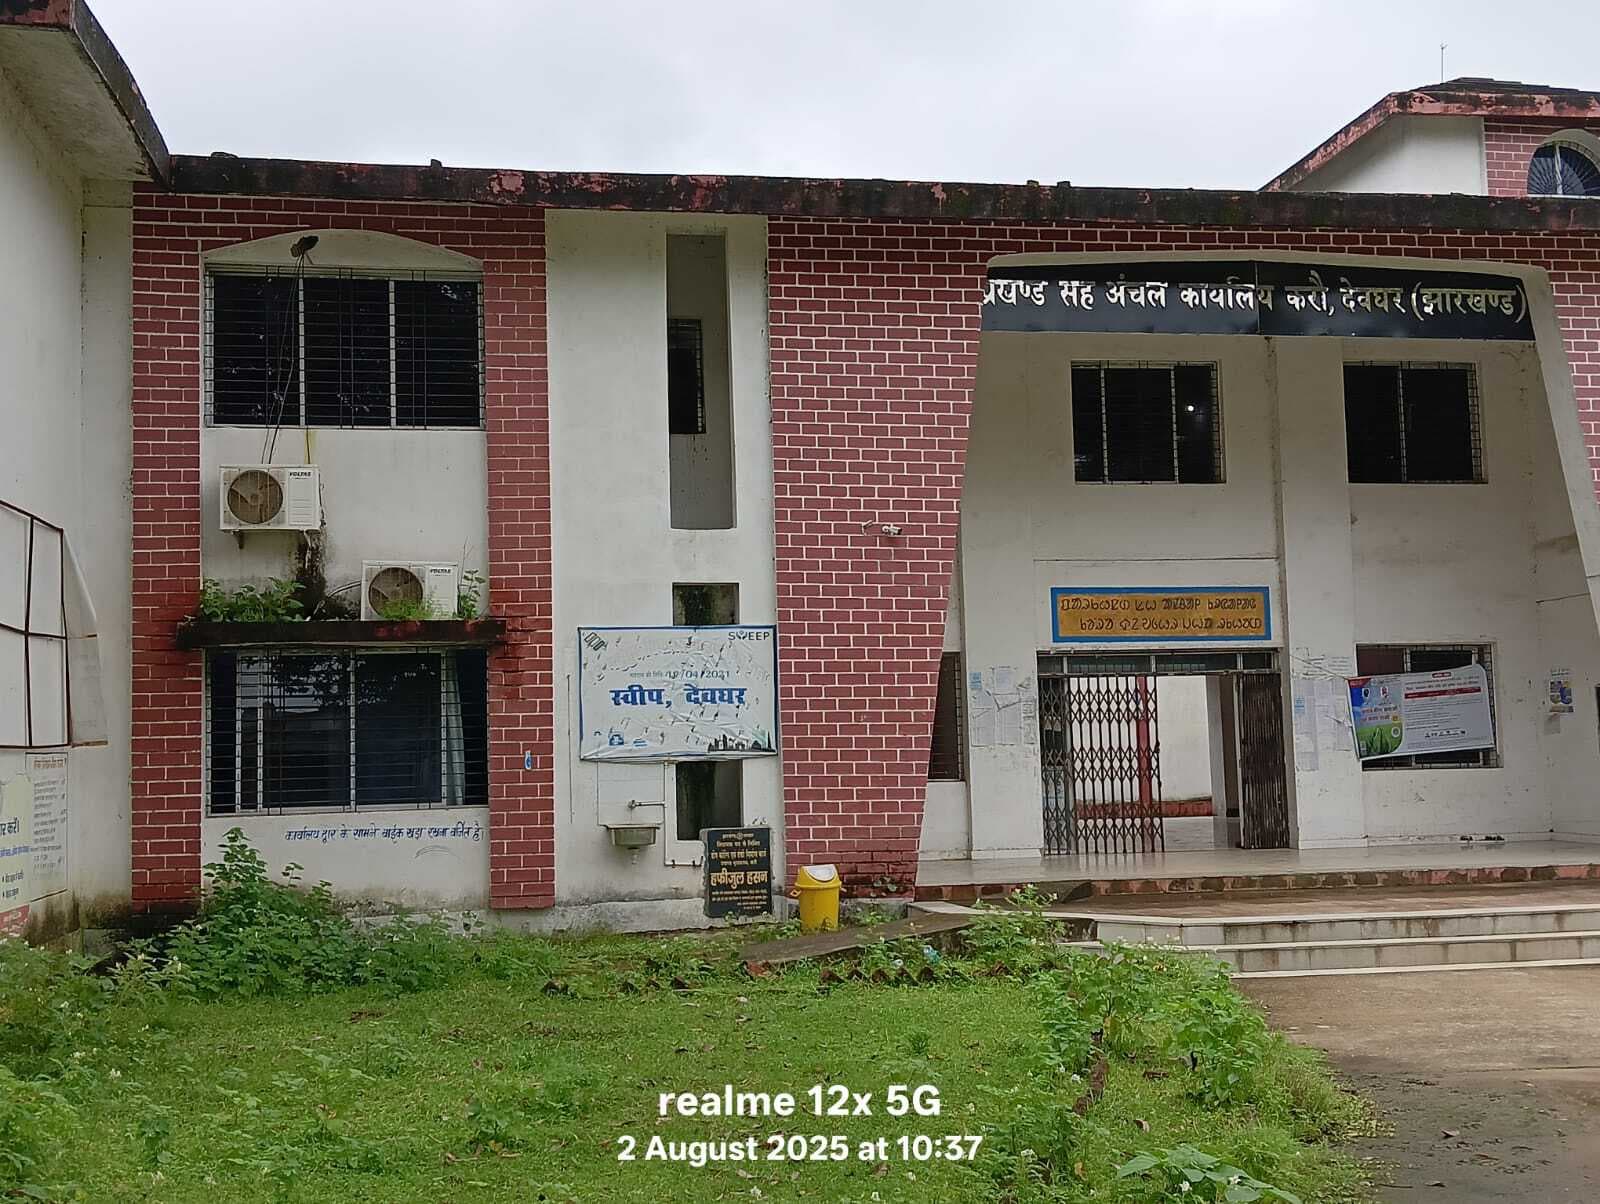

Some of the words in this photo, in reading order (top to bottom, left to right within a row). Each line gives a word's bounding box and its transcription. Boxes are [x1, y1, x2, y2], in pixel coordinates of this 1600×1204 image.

[1057, 280, 1097, 310] सह
[1105, 272, 1169, 310] अंचल
[1178, 275, 1275, 312] कार्यालय
[1339, 276, 1407, 315] देवघर
[728, 630, 770, 641] SWEEP
[609, 684, 672, 709] स्वीप,
[683, 683, 747, 705] देवघर
[747, 871, 768, 884] हसन
